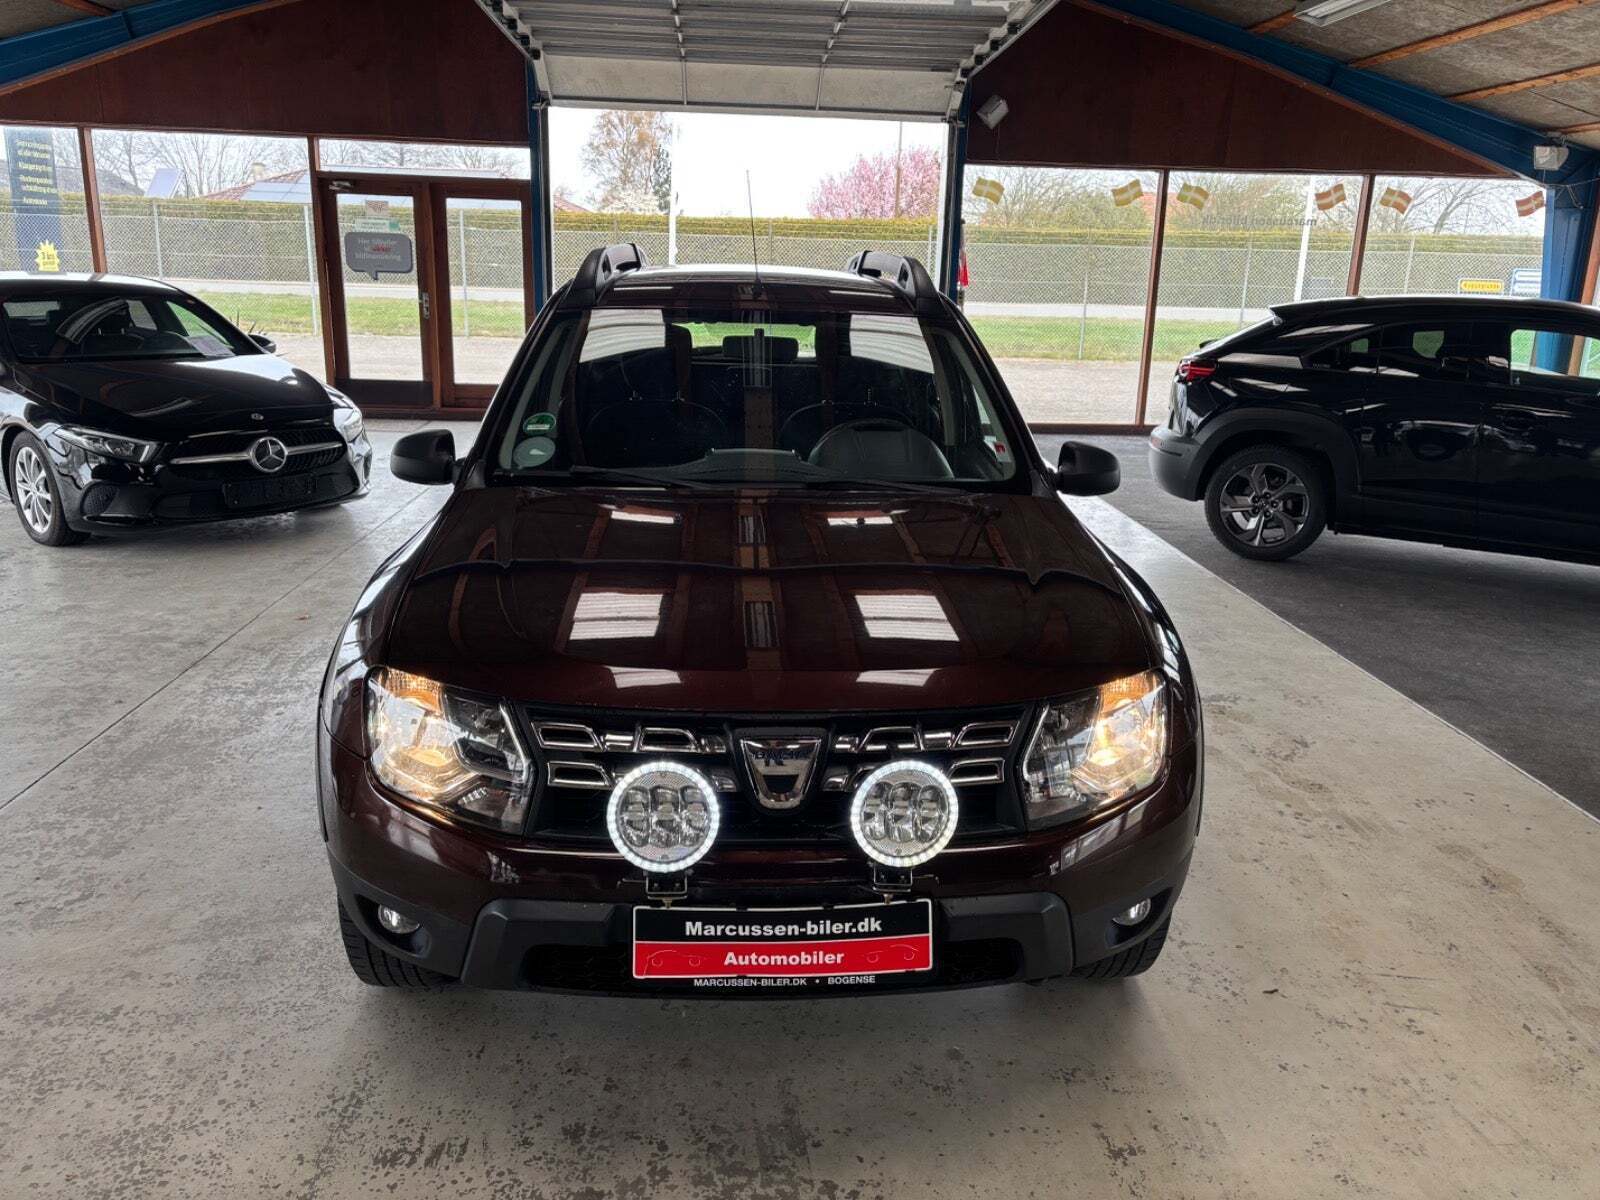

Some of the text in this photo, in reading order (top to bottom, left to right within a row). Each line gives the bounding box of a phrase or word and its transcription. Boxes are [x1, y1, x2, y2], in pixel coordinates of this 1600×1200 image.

[684, 917, 883, 937] Marcussen-biler.dk
[723, 950, 845, 967] Automobiler
[693, 975, 876, 988] MARCUSSEN-BILER.DK BOGENSE
